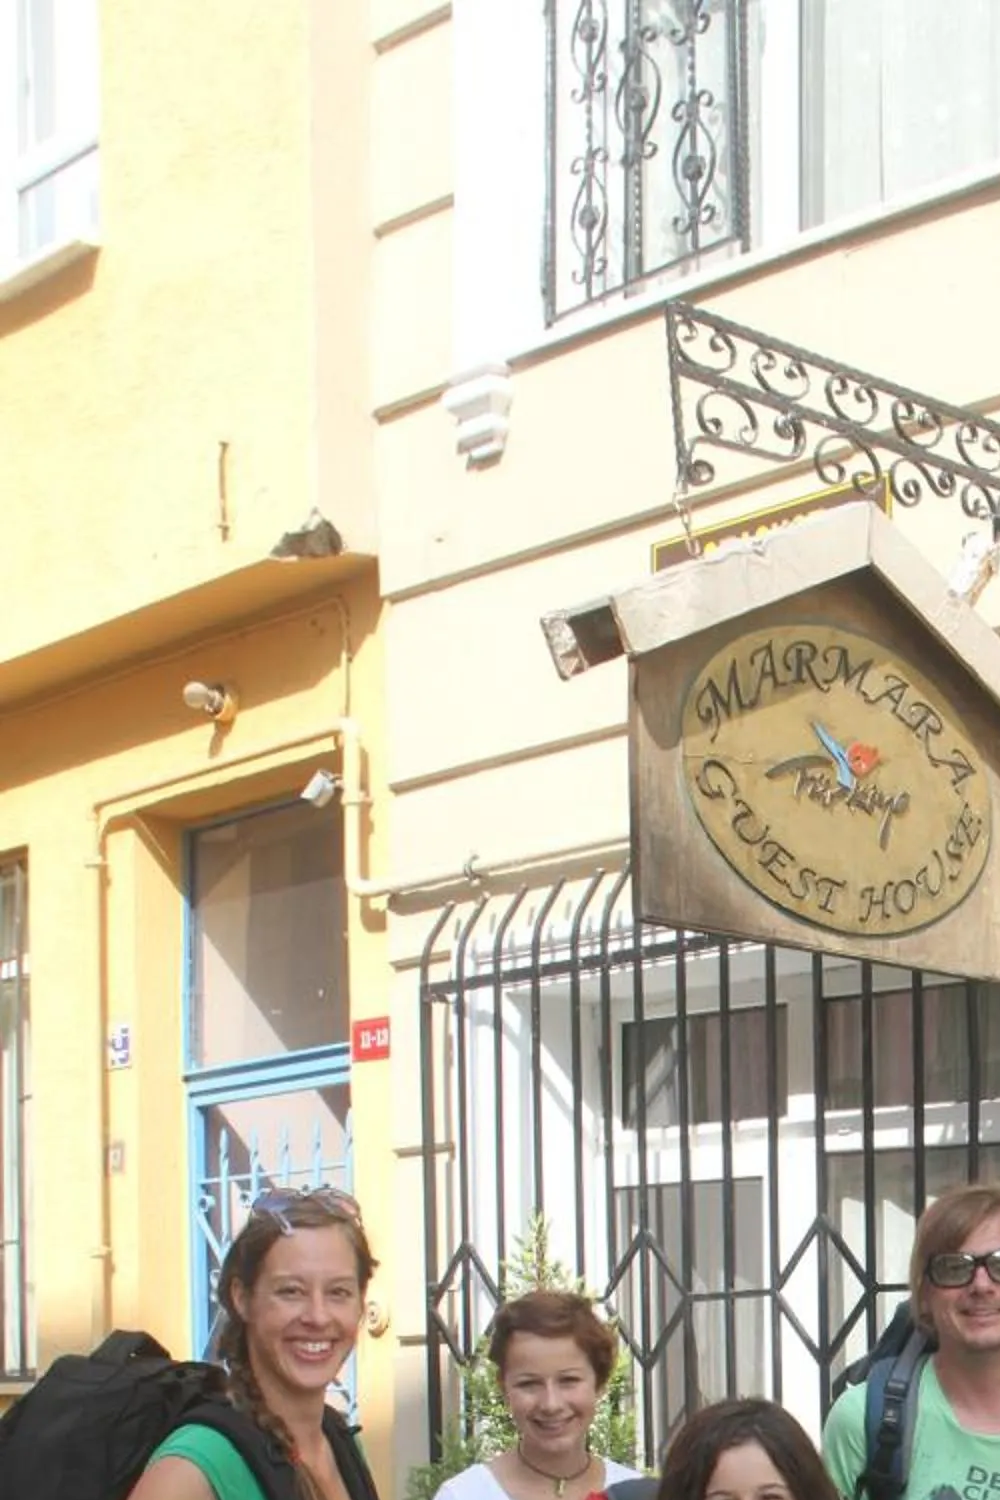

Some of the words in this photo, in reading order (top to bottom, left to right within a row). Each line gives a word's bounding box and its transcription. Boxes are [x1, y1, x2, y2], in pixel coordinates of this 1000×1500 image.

[696, 640, 976, 795] MARMARA
[696, 759, 848, 914] GUEST
[859, 802, 982, 922] HOUSE
